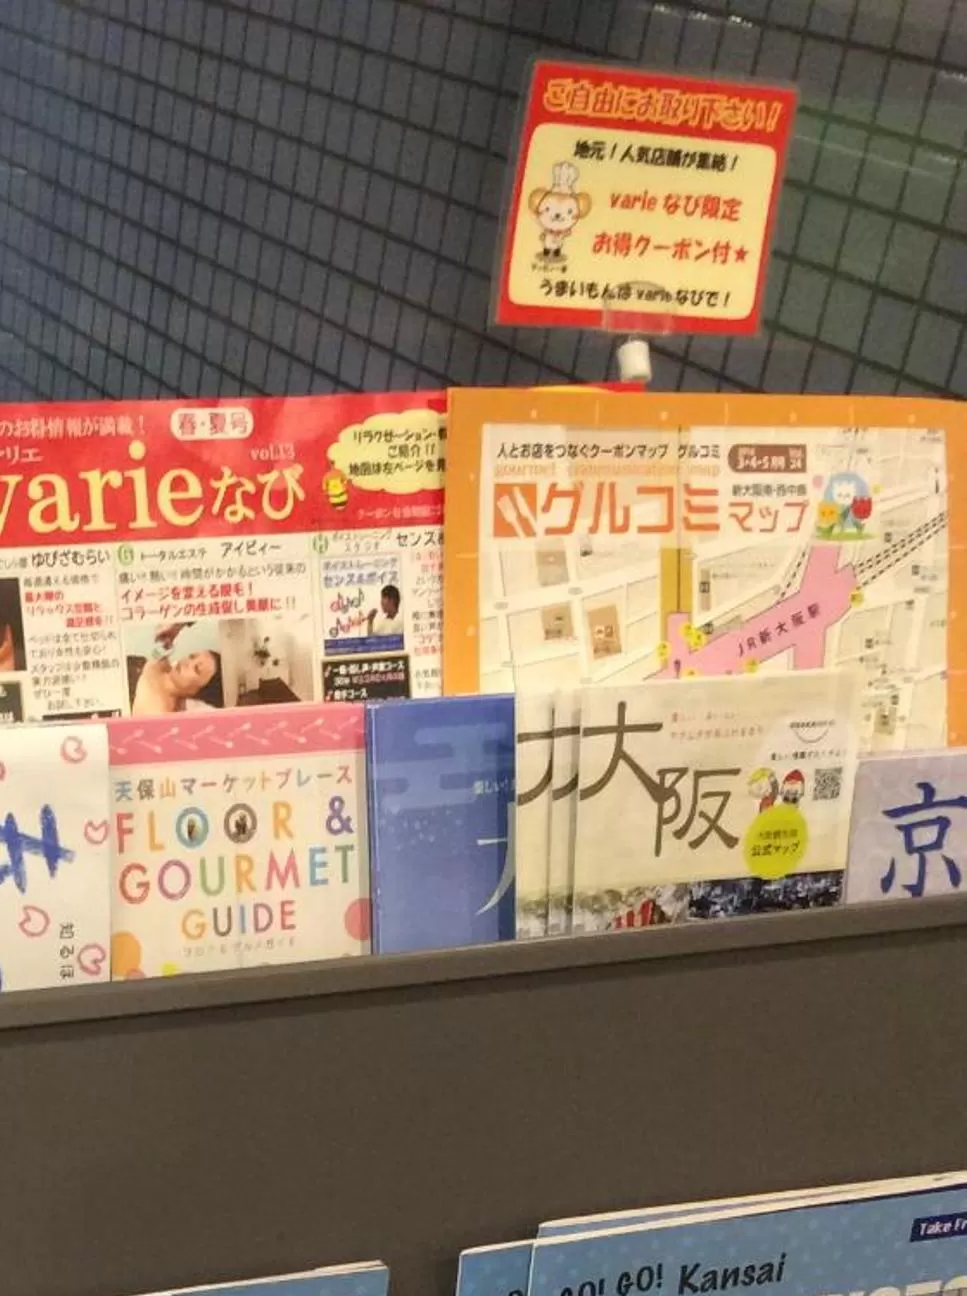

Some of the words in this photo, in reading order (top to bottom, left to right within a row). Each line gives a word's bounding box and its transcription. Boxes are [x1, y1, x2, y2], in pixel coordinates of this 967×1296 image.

[496, 442, 669, 460] 人とお店をつなぐクーポンマップ
[677, 442, 721, 459] グルコミ
[727, 501, 810, 535] マップ
[32, 549, 110, 568] ゆびざむらい
[579, 699, 743, 858] 大阪
[115, 799, 295, 855] FLOOR
[325, 795, 355, 836] &
[750, 840, 801, 857] 公式マップ
[118, 843, 355, 906] GOURMET
[181, 899, 297, 941] GUIDE
[919, 1221, 952, 1237] Take
[677, 1252, 788, 1296] Kansai
